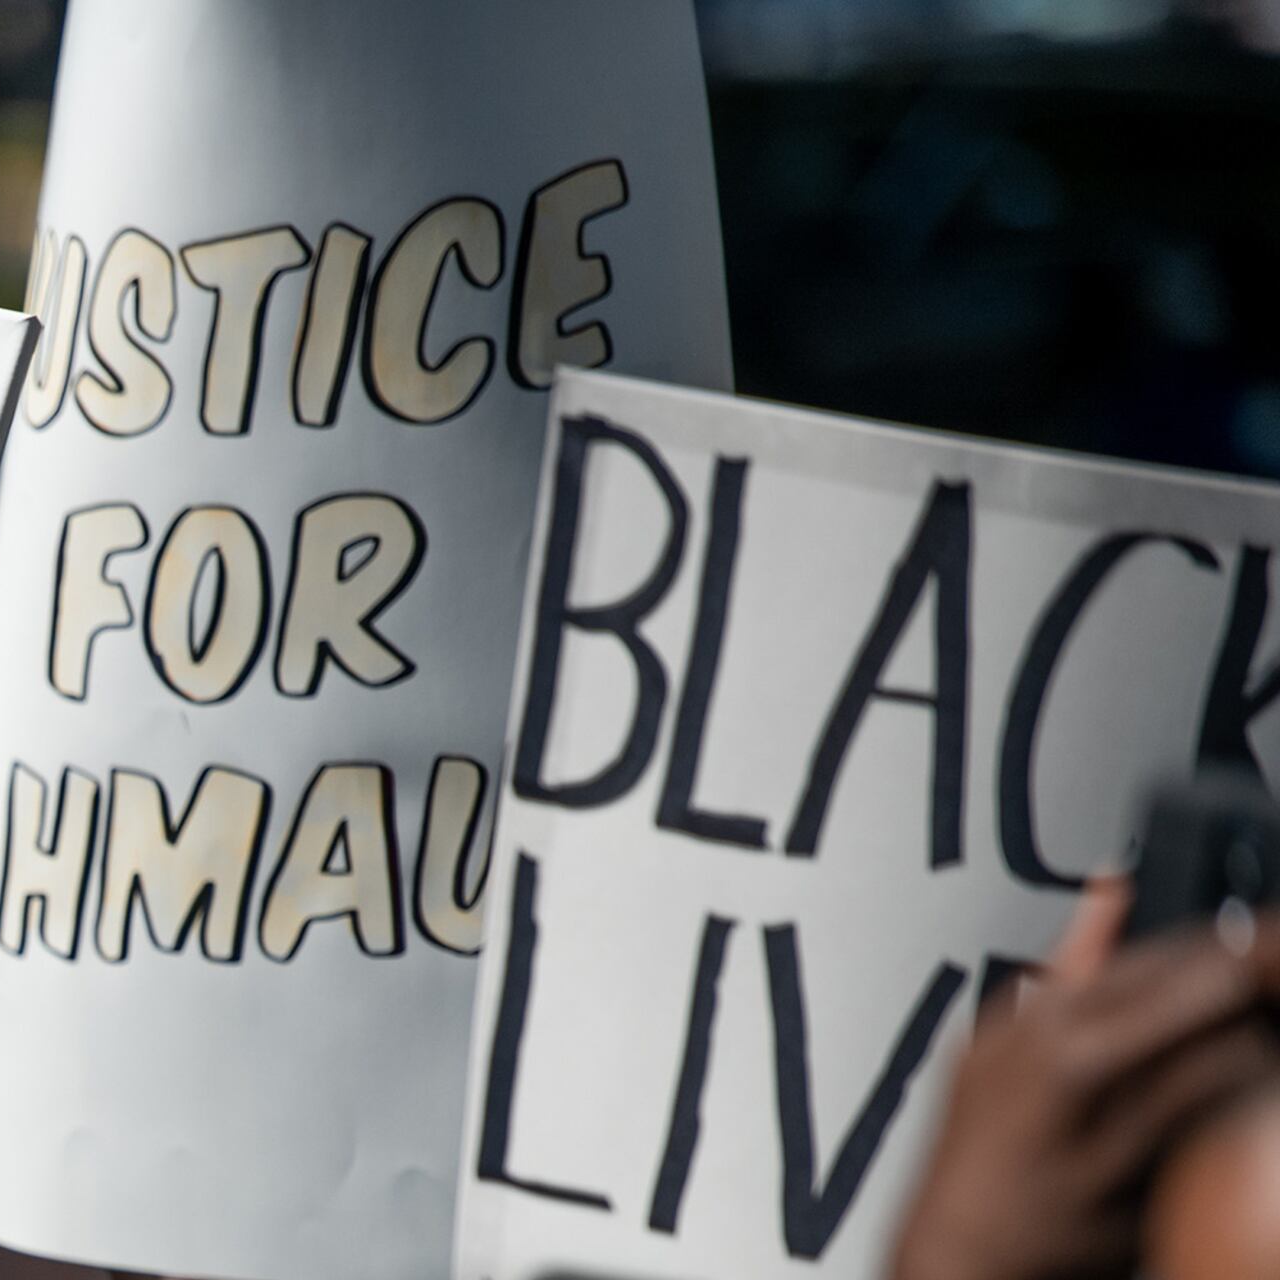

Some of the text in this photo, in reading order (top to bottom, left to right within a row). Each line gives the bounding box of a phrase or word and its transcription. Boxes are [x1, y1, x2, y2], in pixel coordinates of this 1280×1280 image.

[24, 158, 630, 437] USTICE
[47, 491, 427, 704] FOR
[477, 850, 1045, 1263] LIV
